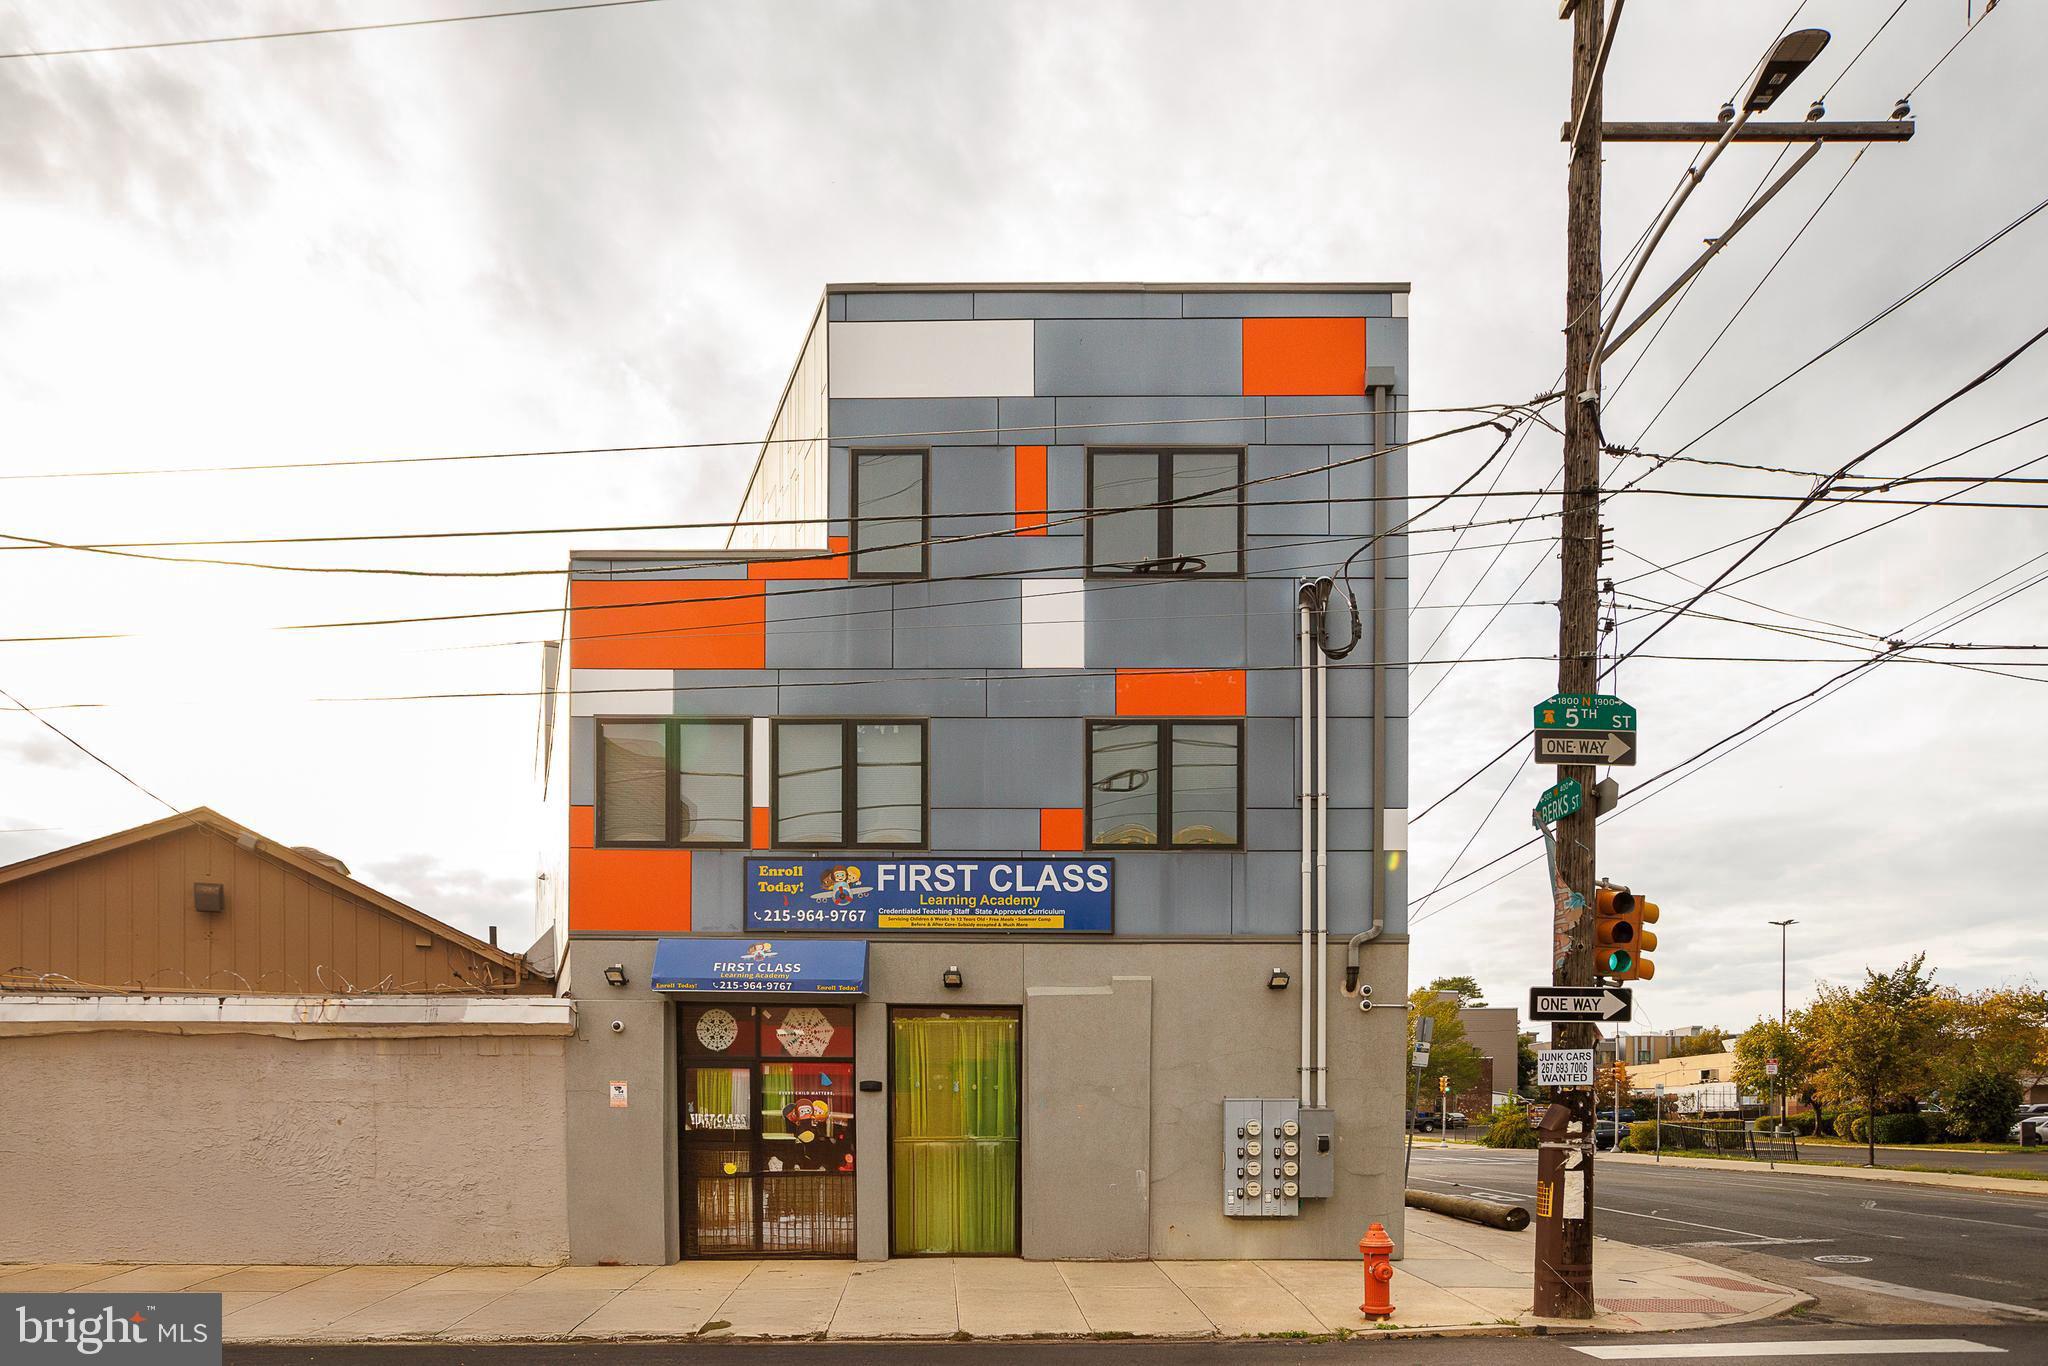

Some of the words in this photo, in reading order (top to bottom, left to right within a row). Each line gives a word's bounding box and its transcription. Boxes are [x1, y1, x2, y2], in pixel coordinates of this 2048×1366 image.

[1558, 697, 1579, 705] 1800
[1582, 697, 1591, 707] N
[1595, 698, 1615, 706] 1900
[1566, 708, 1597, 727] 5TH
[1612, 715, 1631, 729] ST
[1547, 740, 1574, 753] ONE
[1579, 740, 1607, 754] WAY
[1542, 794, 1569, 824] BERKS
[1571, 794, 1579, 810] ST
[758, 865, 803, 877] Enroll
[877, 864, 978, 892] FIRST
[989, 864, 1109, 893] CLASS
[757, 882, 804, 895] Today!
[920, 894, 977, 909] Learning
[979, 894, 1041, 908] Academy
[763, 909, 867, 922] 215-964-9767
[922, 908, 953, 916] Teaching
[713, 962, 754, 972] FIRST
[757, 963, 801, 973] CLASS
[720, 972, 754, 980] Learning
[719, 981, 792, 991] 215-964-9767
[1540, 998, 1568, 1011] ONE
[1573, 998, 1601, 1011] WAY
[1540, 1052, 1564, 1062] JUNK
[1565, 1052, 1592, 1061] CARS
[1541, 1063, 1553, 1074] 267
[1555, 1063, 1569, 1074] 693
[1570, 1062, 1588, 1073] 7006
[1542, 1073, 1588, 1082] WANTED
